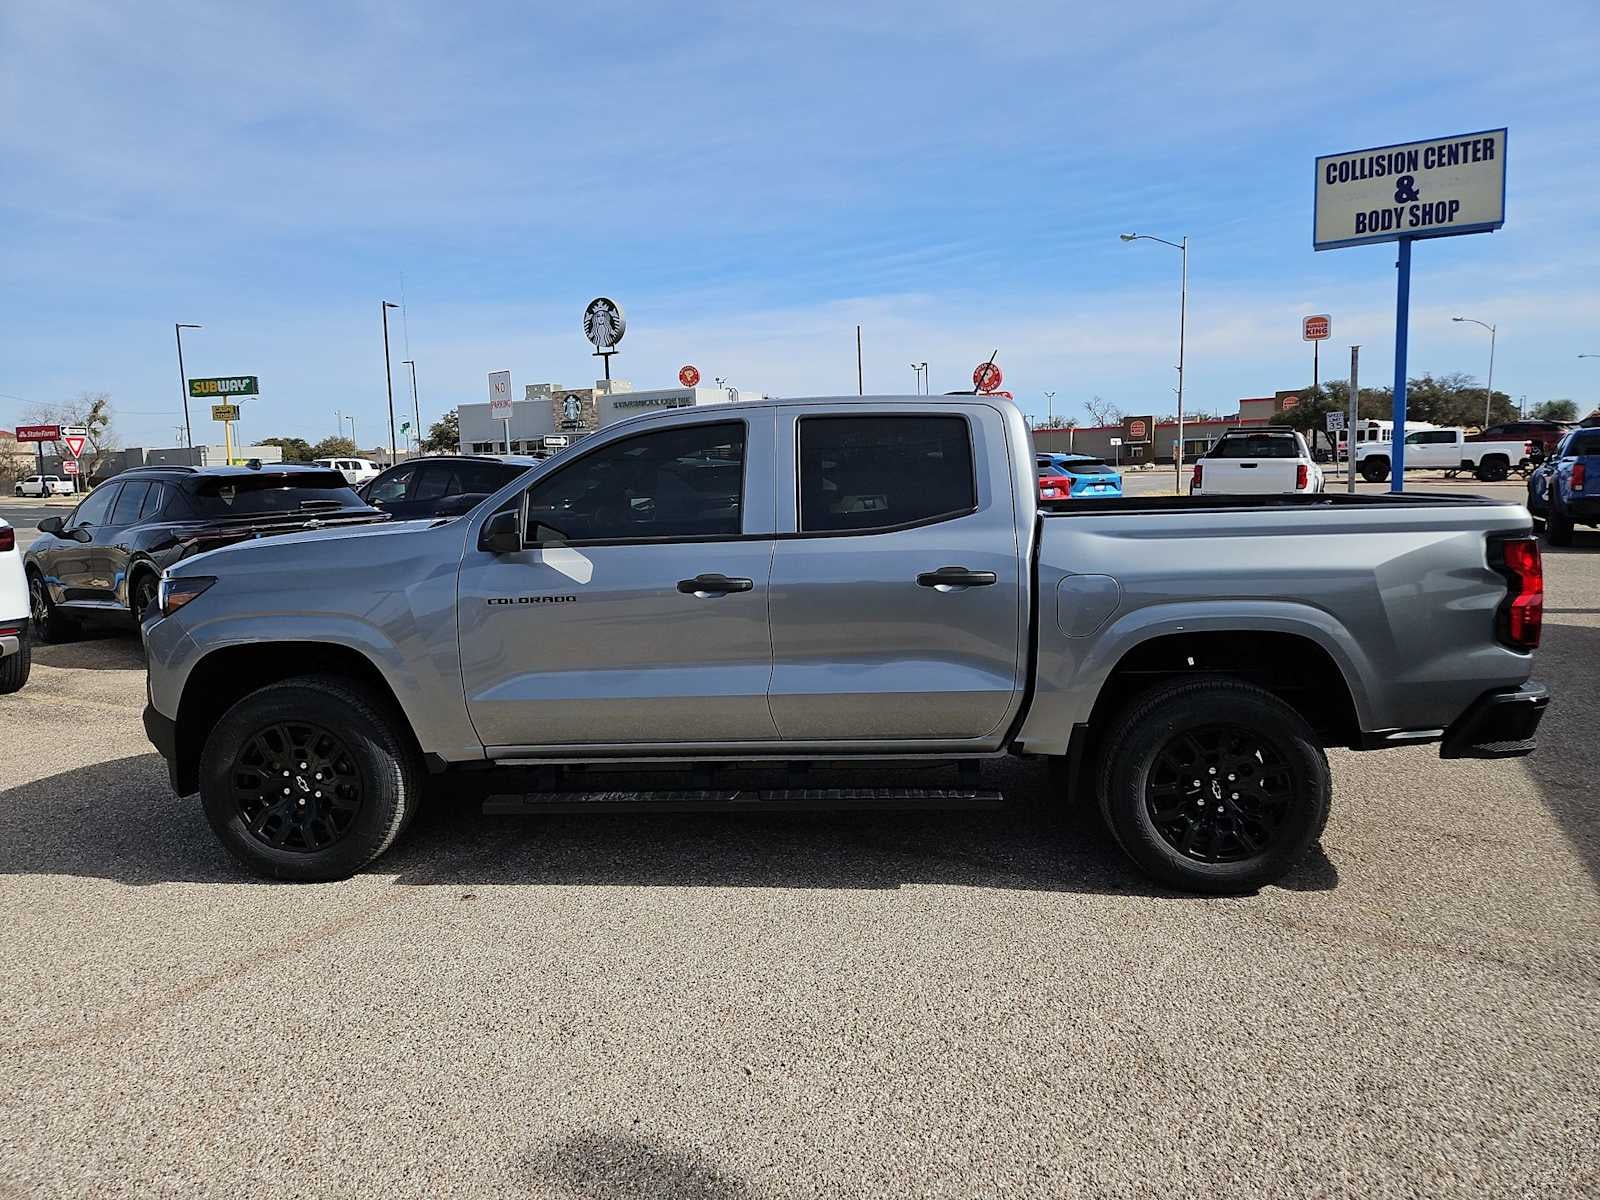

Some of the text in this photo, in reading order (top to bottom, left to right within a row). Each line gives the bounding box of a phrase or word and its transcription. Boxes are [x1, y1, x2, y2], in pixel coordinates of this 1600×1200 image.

[1326, 138, 1495, 184] COLLISION CENTER
[1394, 175, 1419, 204] &
[1355, 199, 1460, 234] BODY SHOP
[1306, 327, 1328, 335] KING
[192, 378, 249, 394] SUBWAY
[494, 382, 505, 393] NO
[1329, 421, 1343, 430] 35
[487, 595, 577, 605] COLORADO
